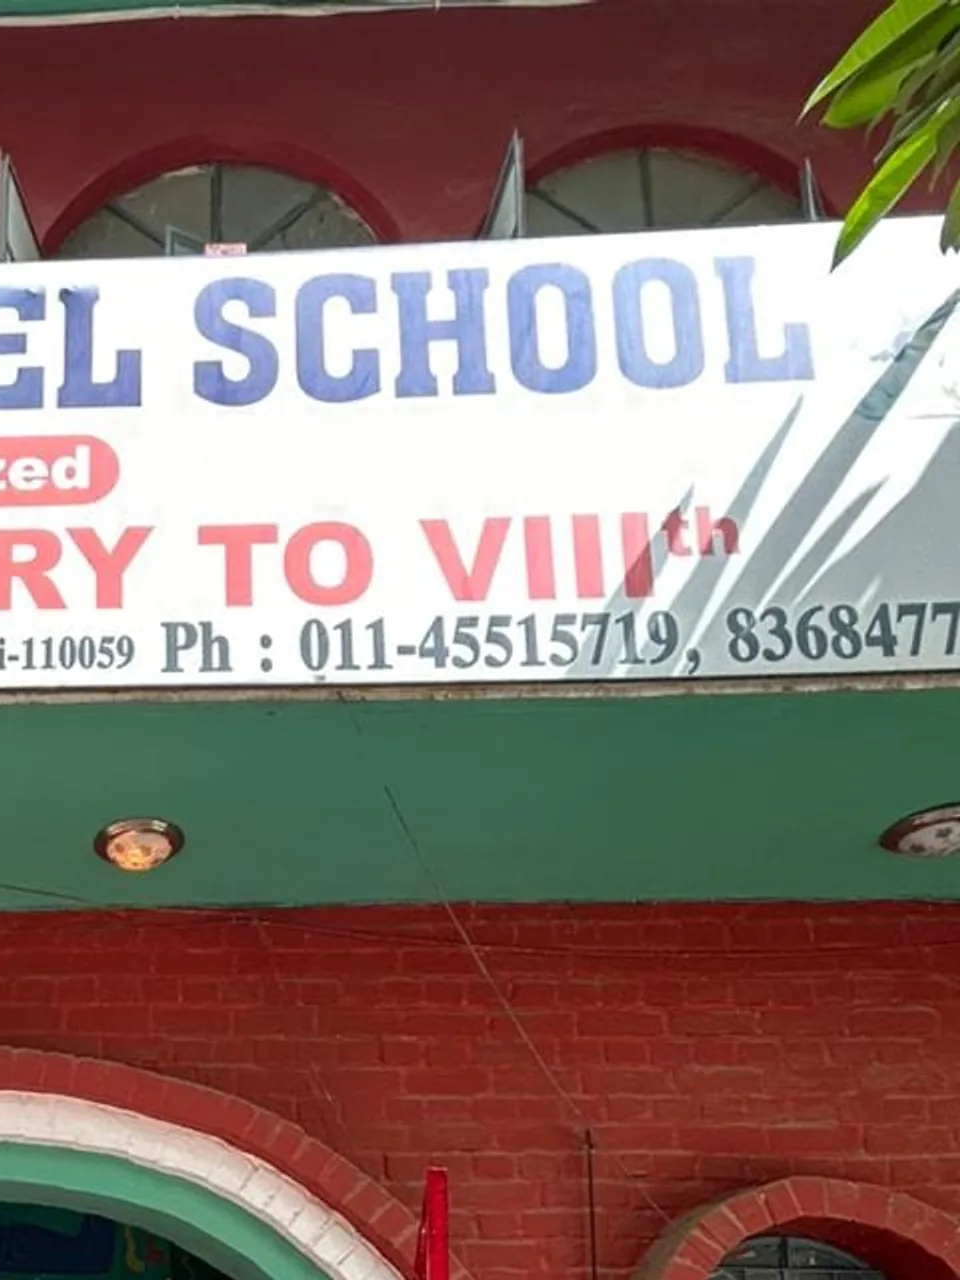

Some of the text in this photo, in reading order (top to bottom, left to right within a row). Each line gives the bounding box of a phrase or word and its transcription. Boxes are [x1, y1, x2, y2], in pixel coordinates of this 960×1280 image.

[193, 256, 815, 406] SCHOOL
[197, 521, 374, 607] TO
[419, 505, 741, 602] VIIIth
[161, 621, 233, 674] Ph
[299, 609, 701, 674] 011-45515719,
